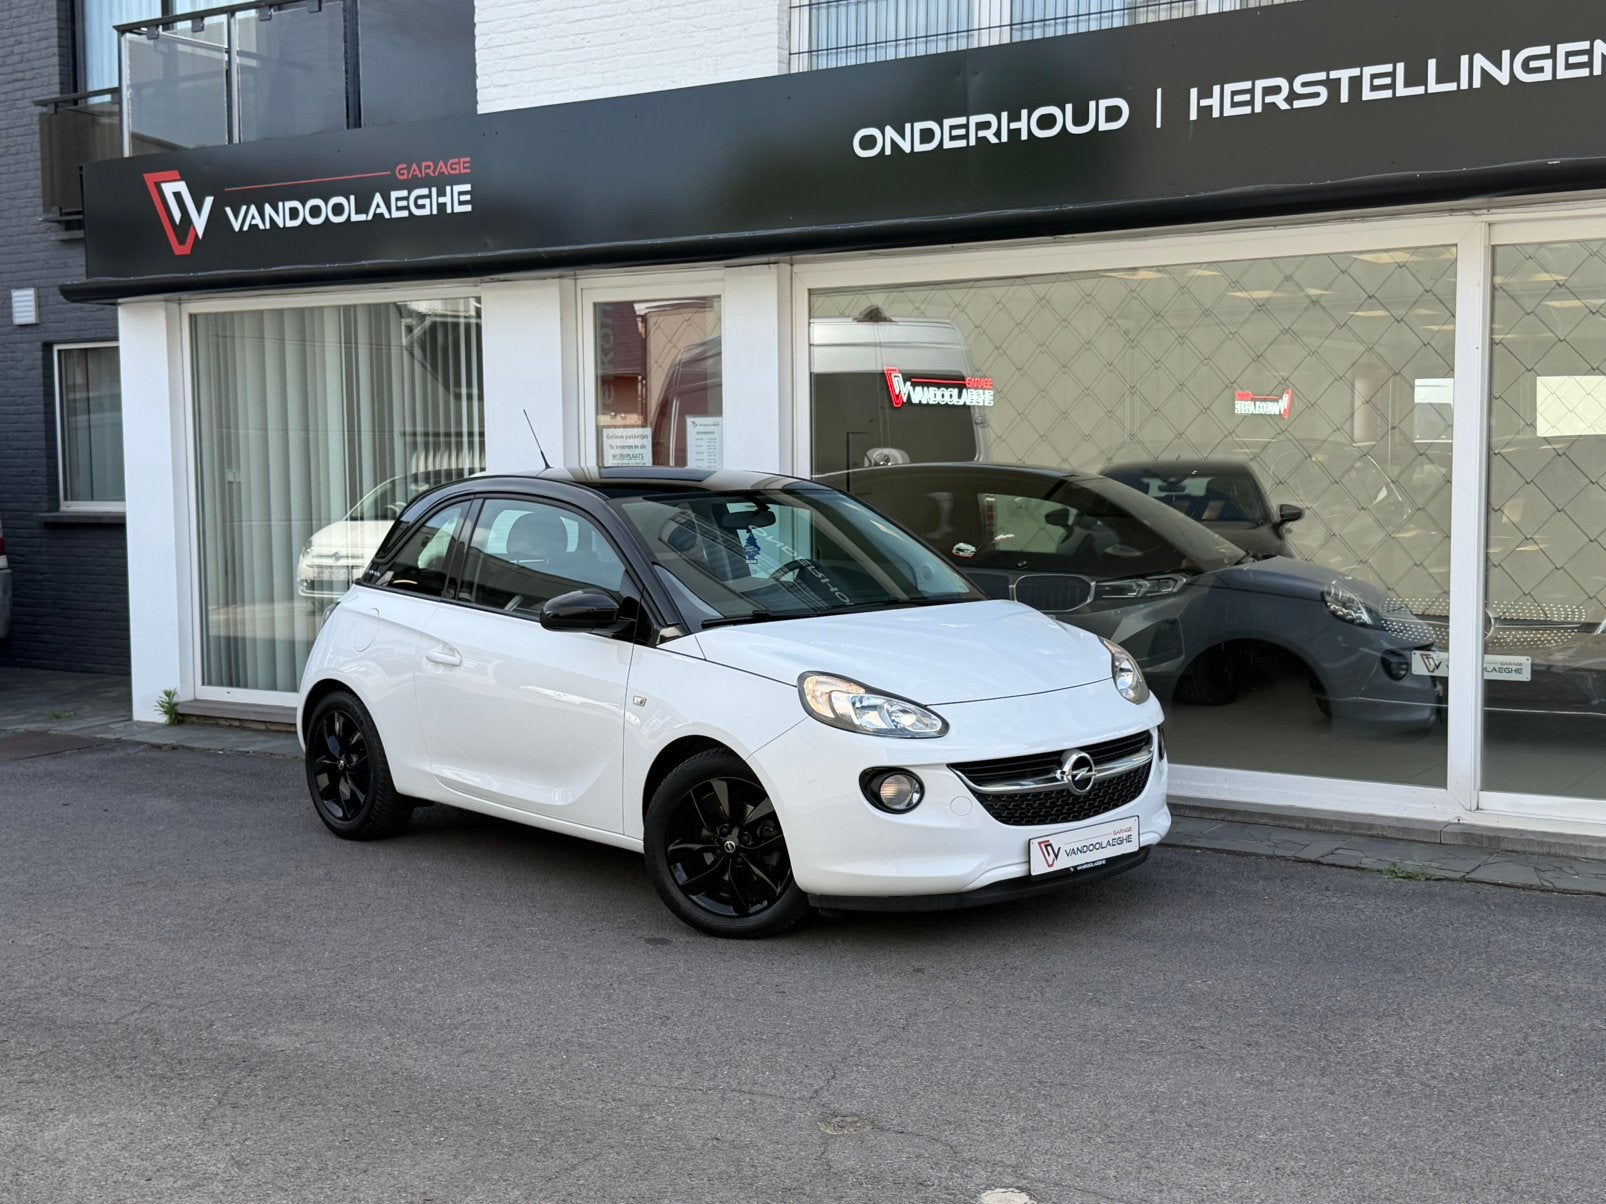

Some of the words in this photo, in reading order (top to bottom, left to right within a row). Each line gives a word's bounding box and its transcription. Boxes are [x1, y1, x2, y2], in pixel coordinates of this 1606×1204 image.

[852, 97, 1130, 158] ONDERHOUD
[395, 157, 471, 180] GARAGE
[224, 183, 472, 232] VANDOOLAEGHE
[1064, 834, 1133, 857] VANDOOLAEGHE
